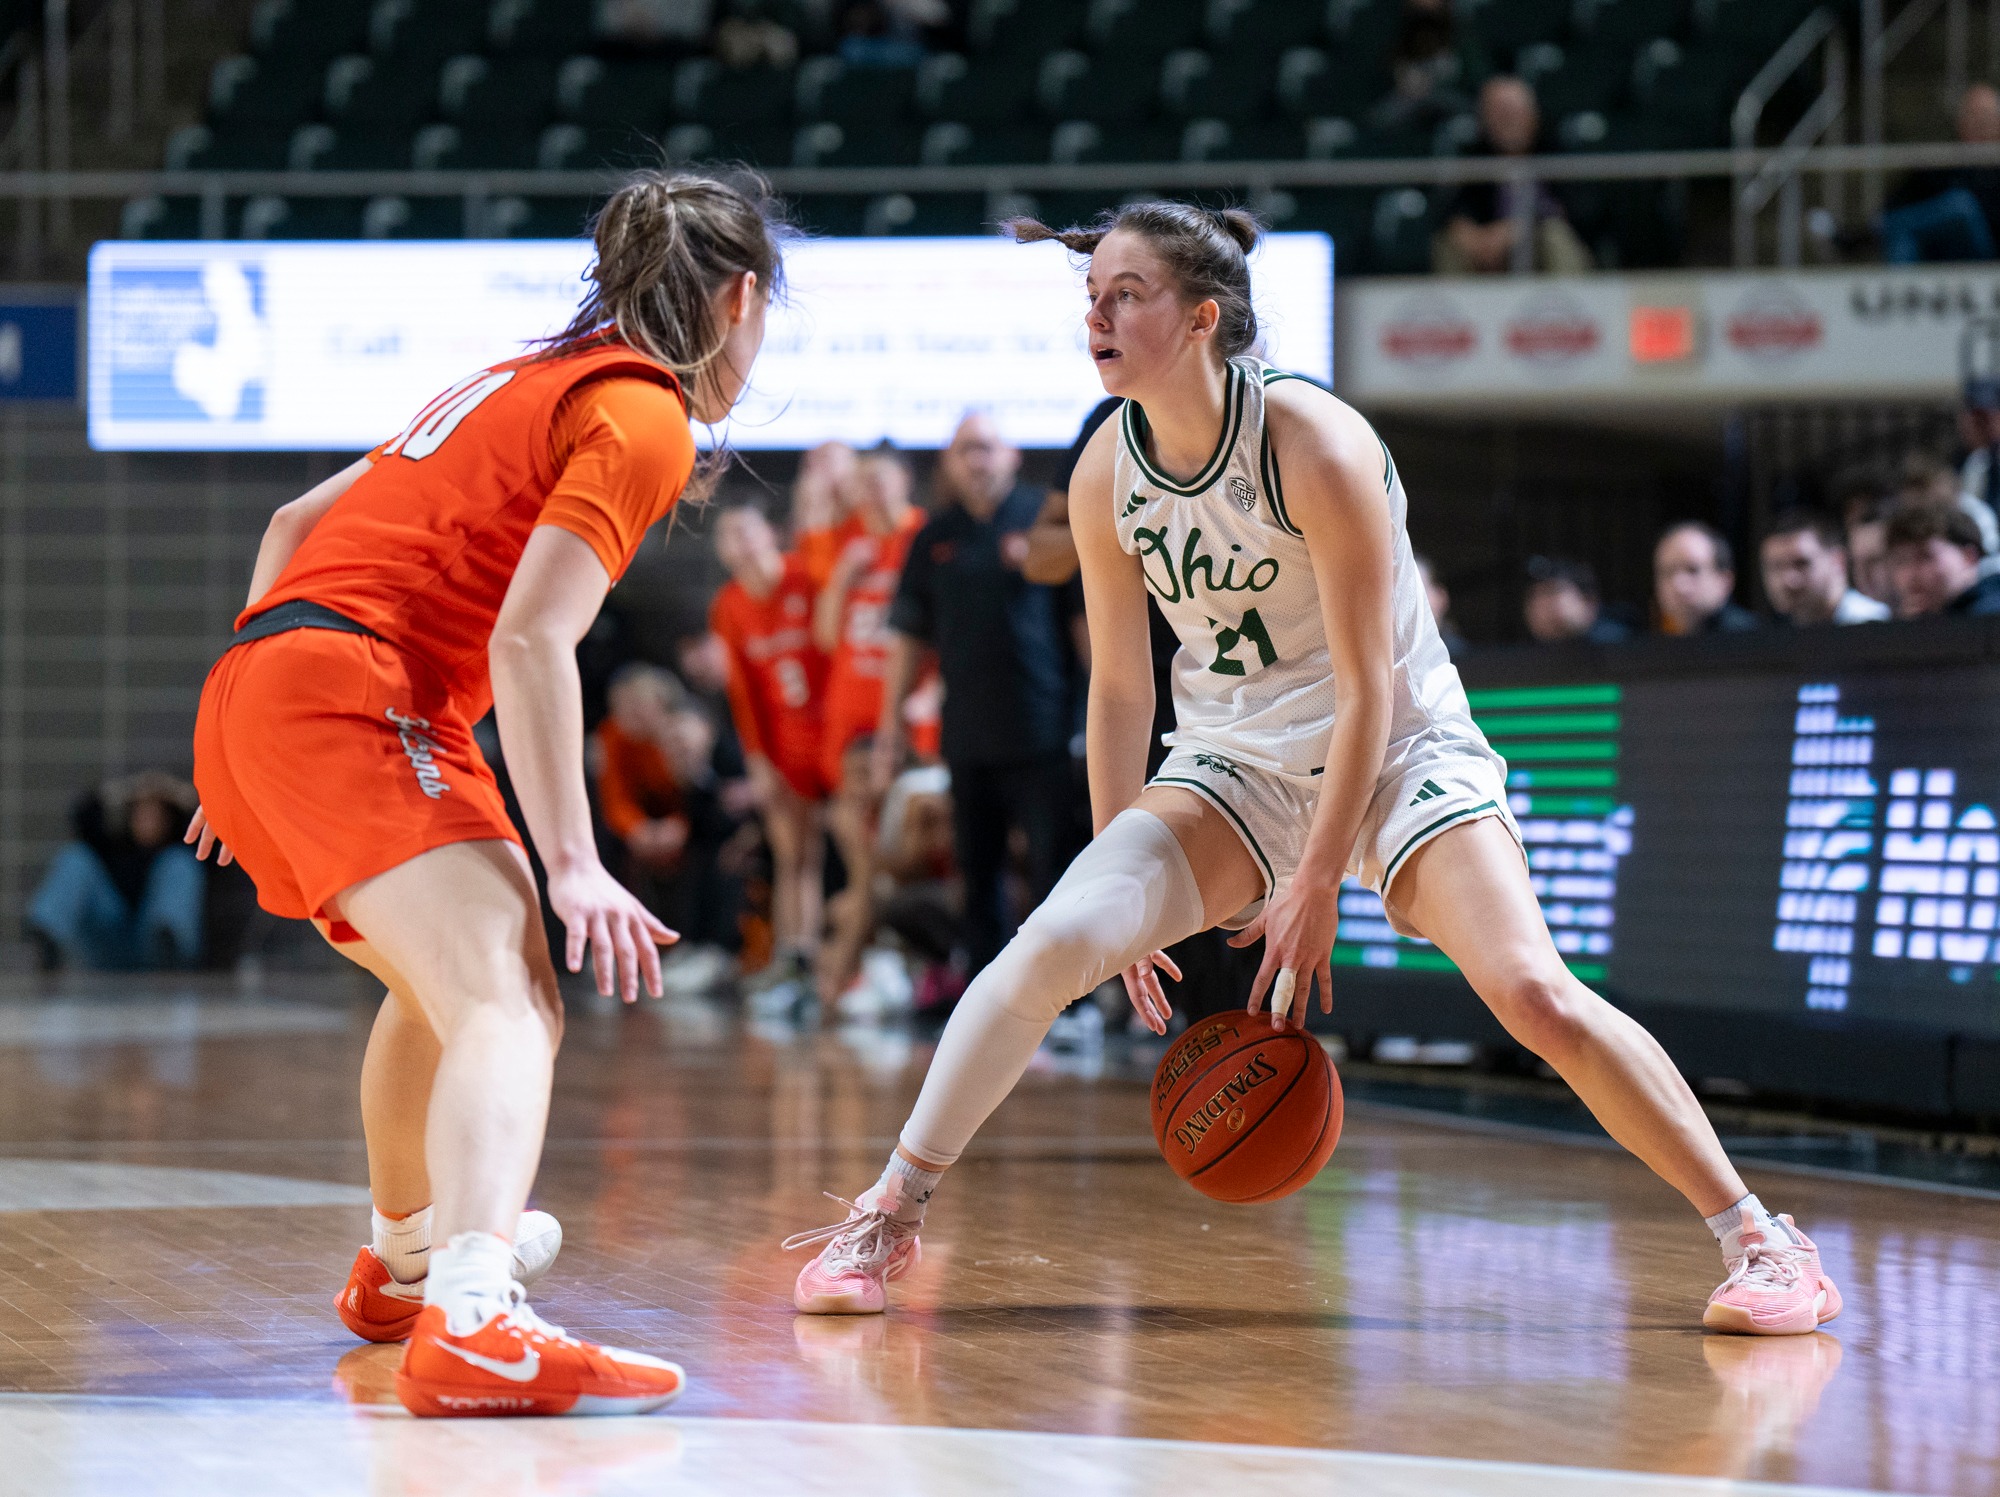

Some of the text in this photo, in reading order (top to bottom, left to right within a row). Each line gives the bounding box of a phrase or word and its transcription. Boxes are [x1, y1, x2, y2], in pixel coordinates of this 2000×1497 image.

[1133, 526, 1279, 604] Ohio
[1203, 607, 1279, 677] 21
[1157, 1026, 1240, 1112] LEGACY
[1173, 1051, 1279, 1155] SPALDING
